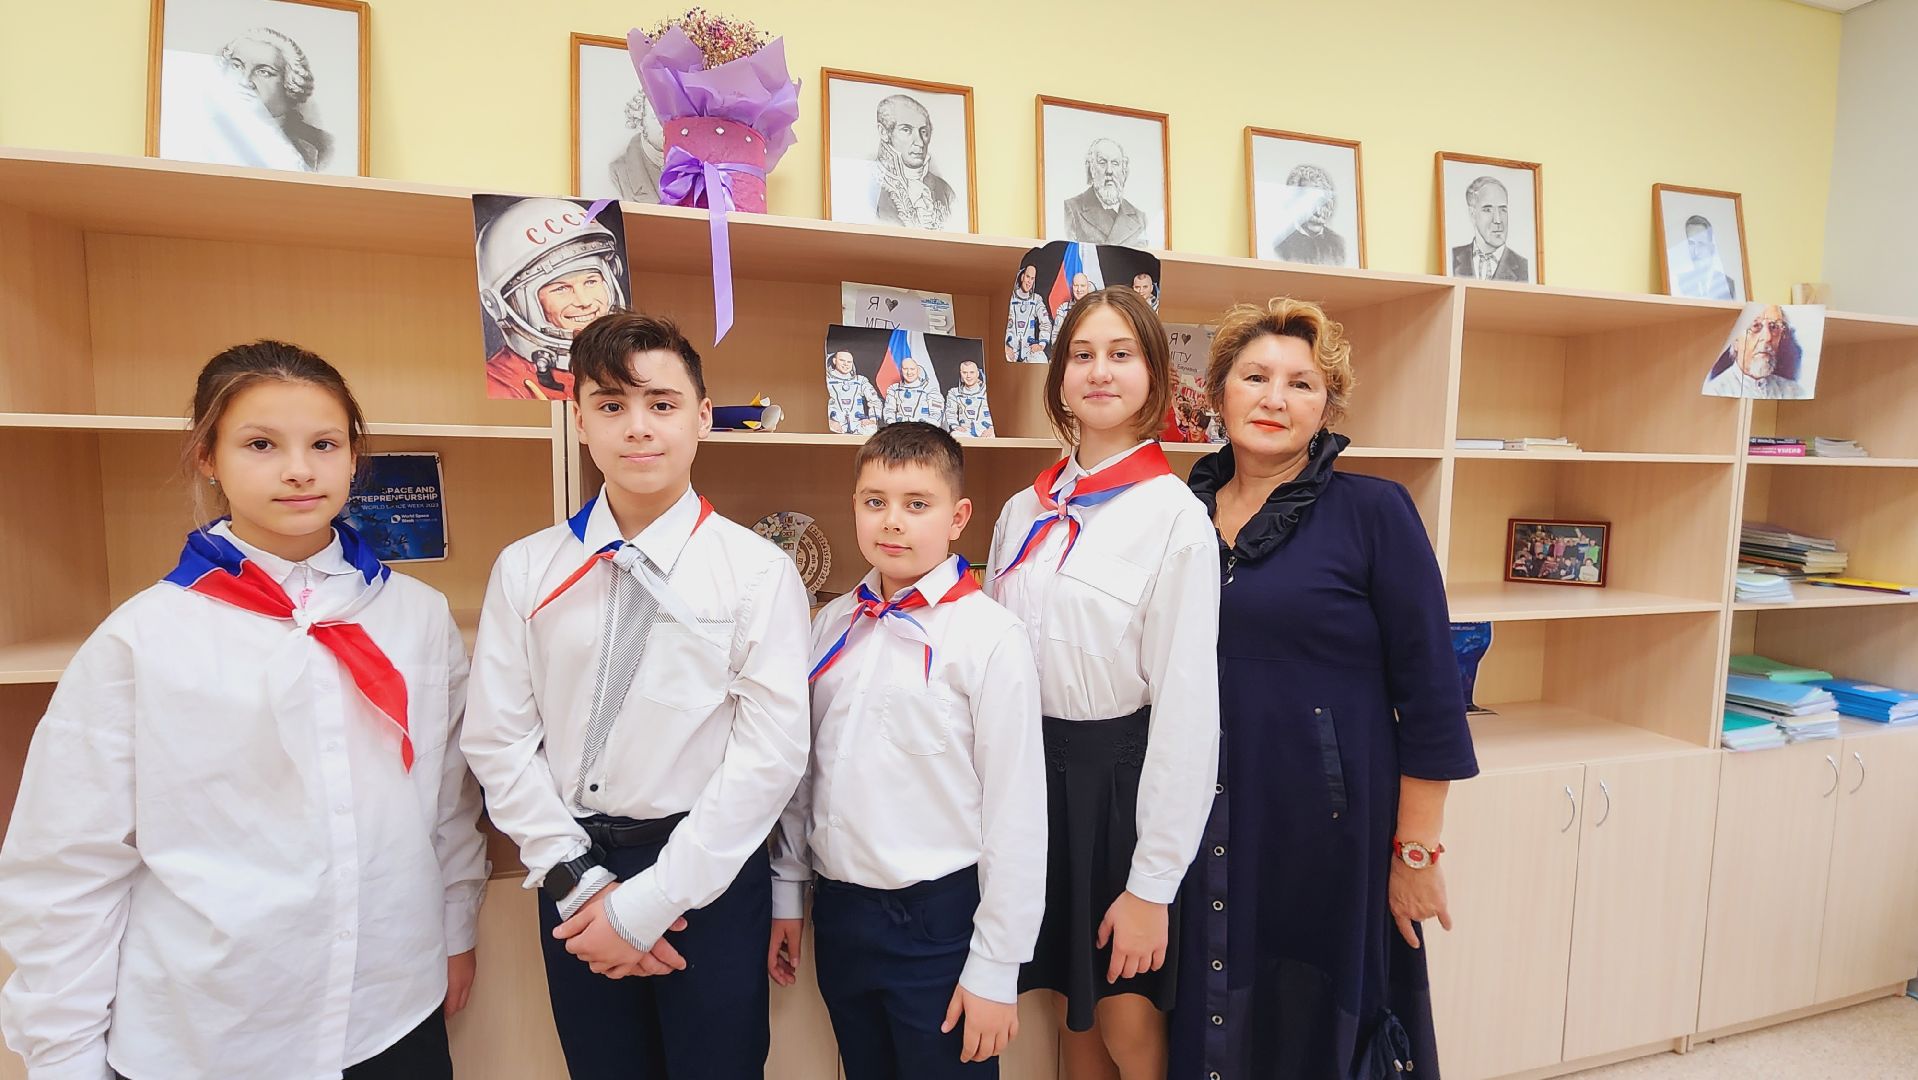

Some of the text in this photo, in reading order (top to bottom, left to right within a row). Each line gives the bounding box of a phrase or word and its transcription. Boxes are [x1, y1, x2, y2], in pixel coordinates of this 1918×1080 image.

[526, 213, 597, 245] ССС
[868, 296, 880, 311] Я
[865, 316, 901, 330] МГТУ
[1169, 332, 1179, 345] Я
[348, 493, 438, 502] NTREPRENEURSHIP
